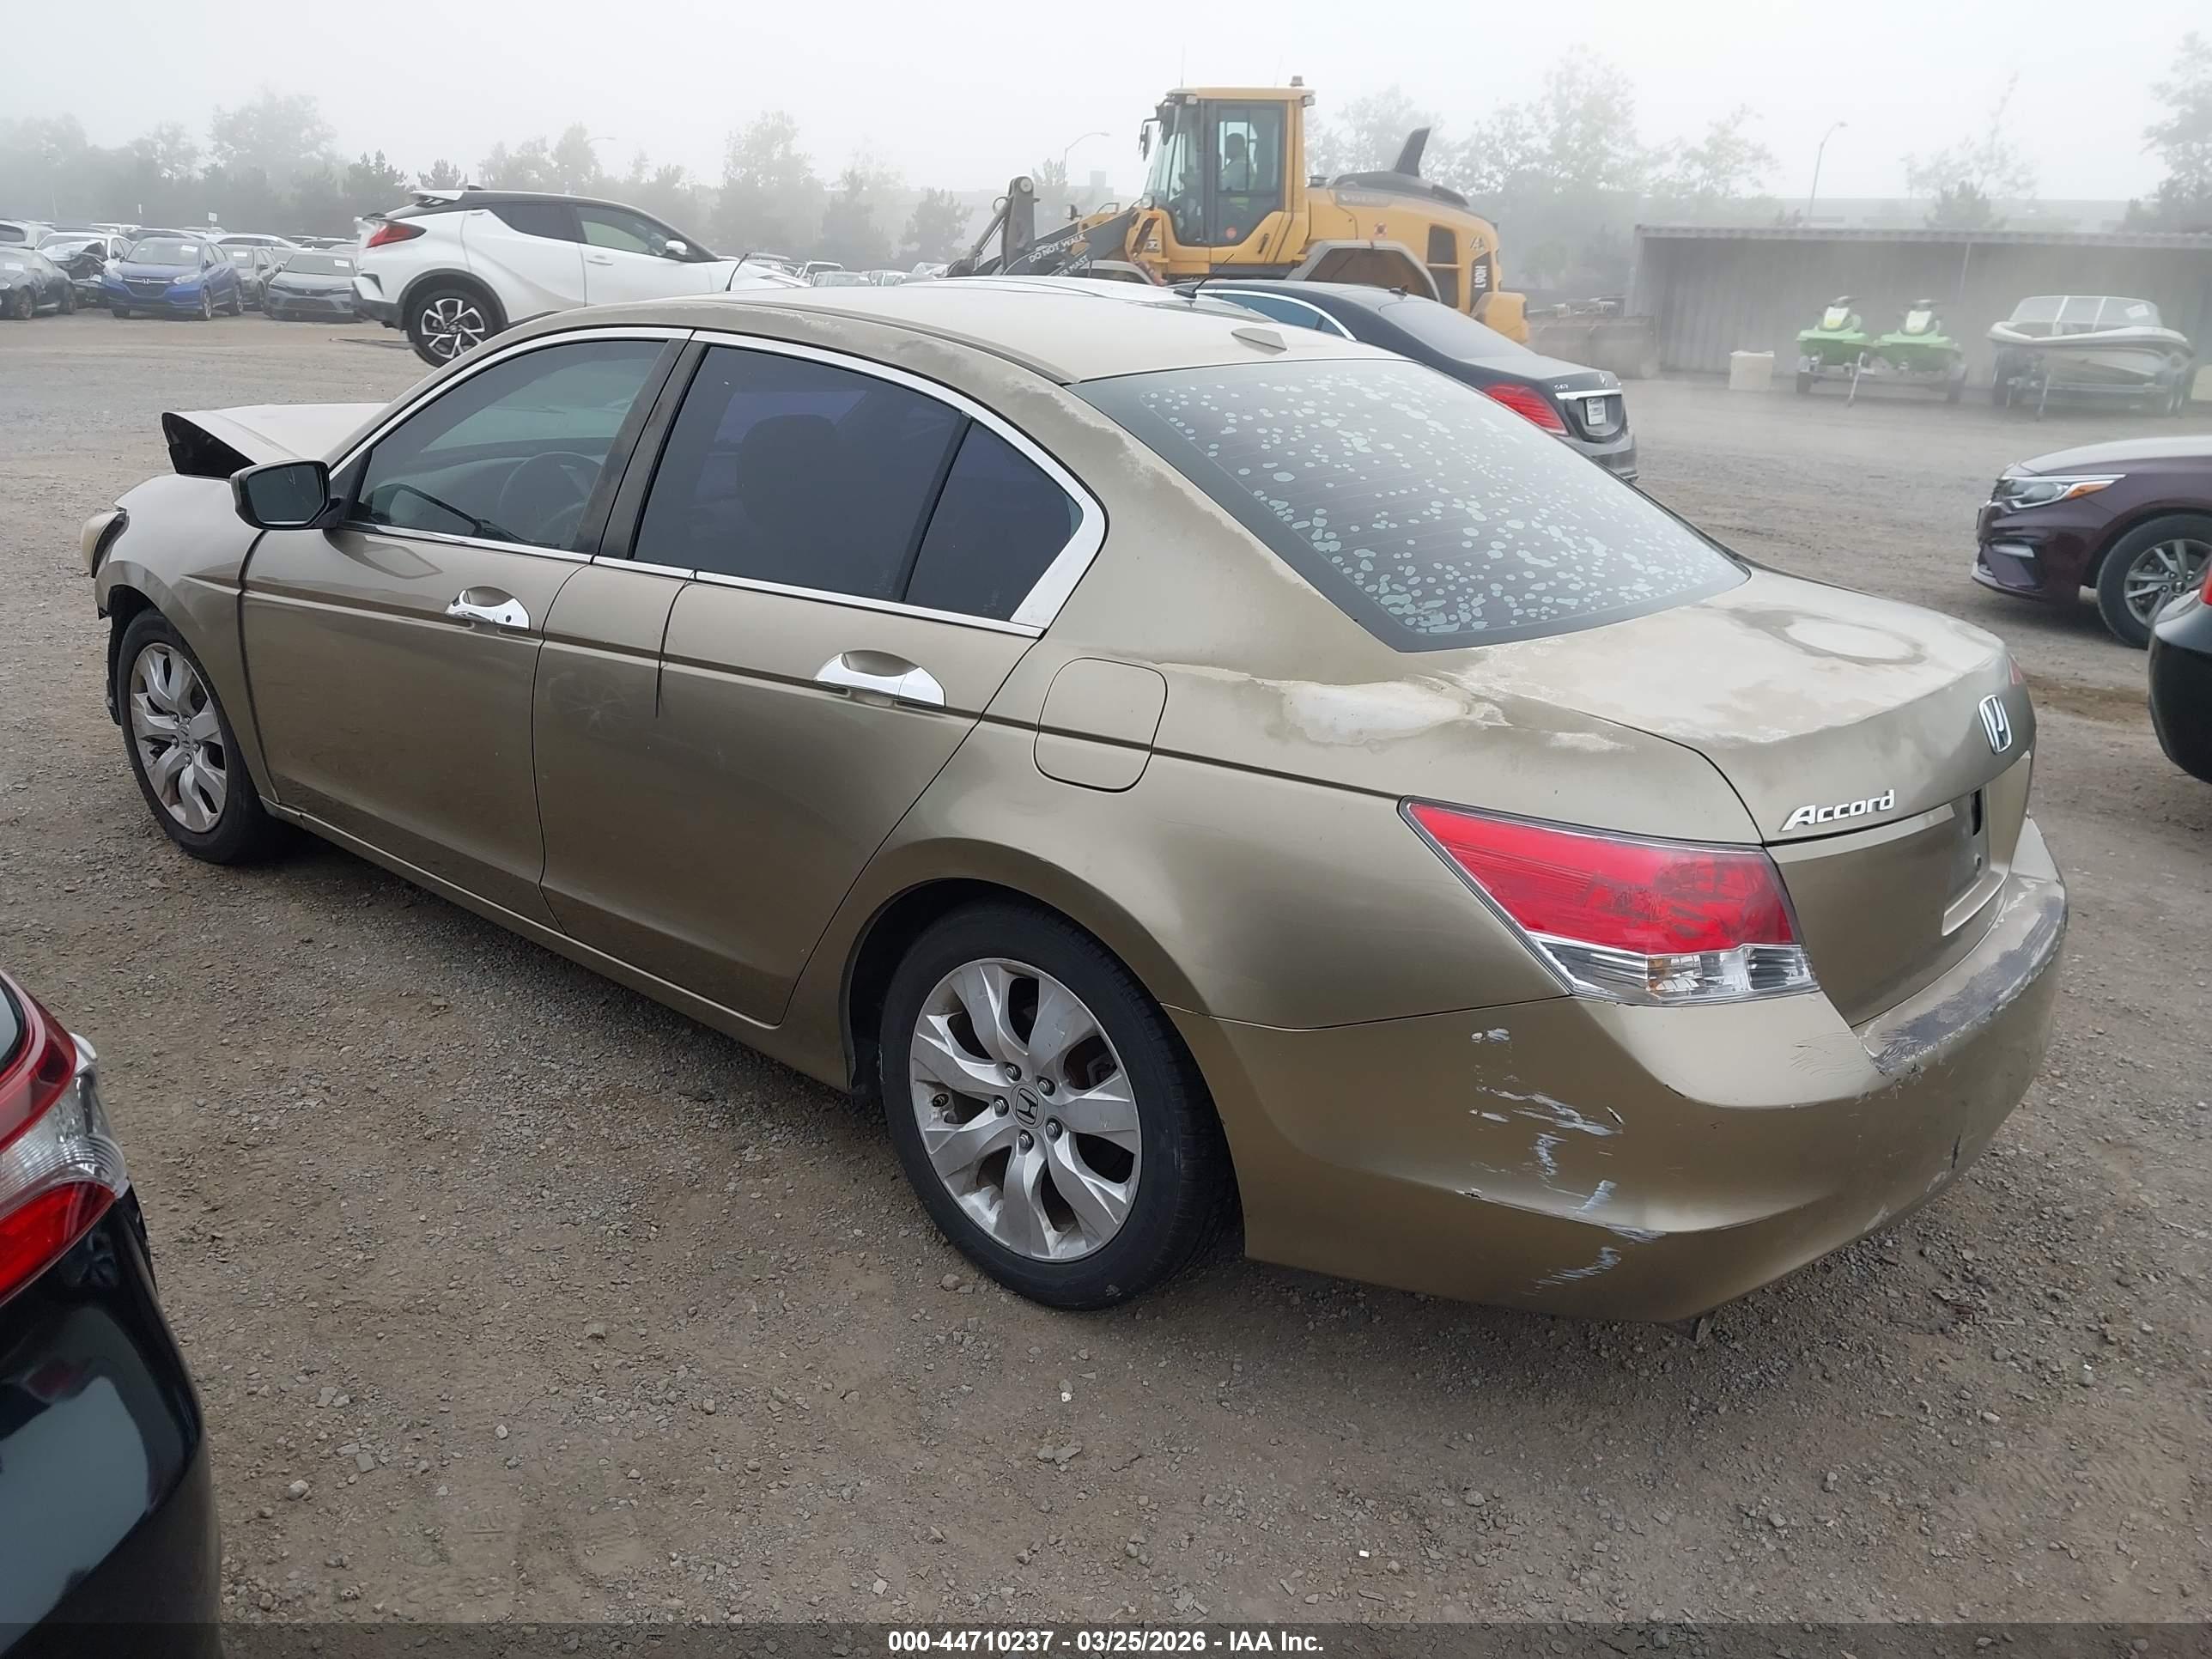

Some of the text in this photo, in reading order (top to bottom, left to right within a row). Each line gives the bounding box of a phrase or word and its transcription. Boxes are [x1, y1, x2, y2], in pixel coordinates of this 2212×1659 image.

[1029, 234, 1085, 263] DO NOT WALK
[1474, 265, 1487, 288] L90H
[1778, 788, 1895, 832] Accord
